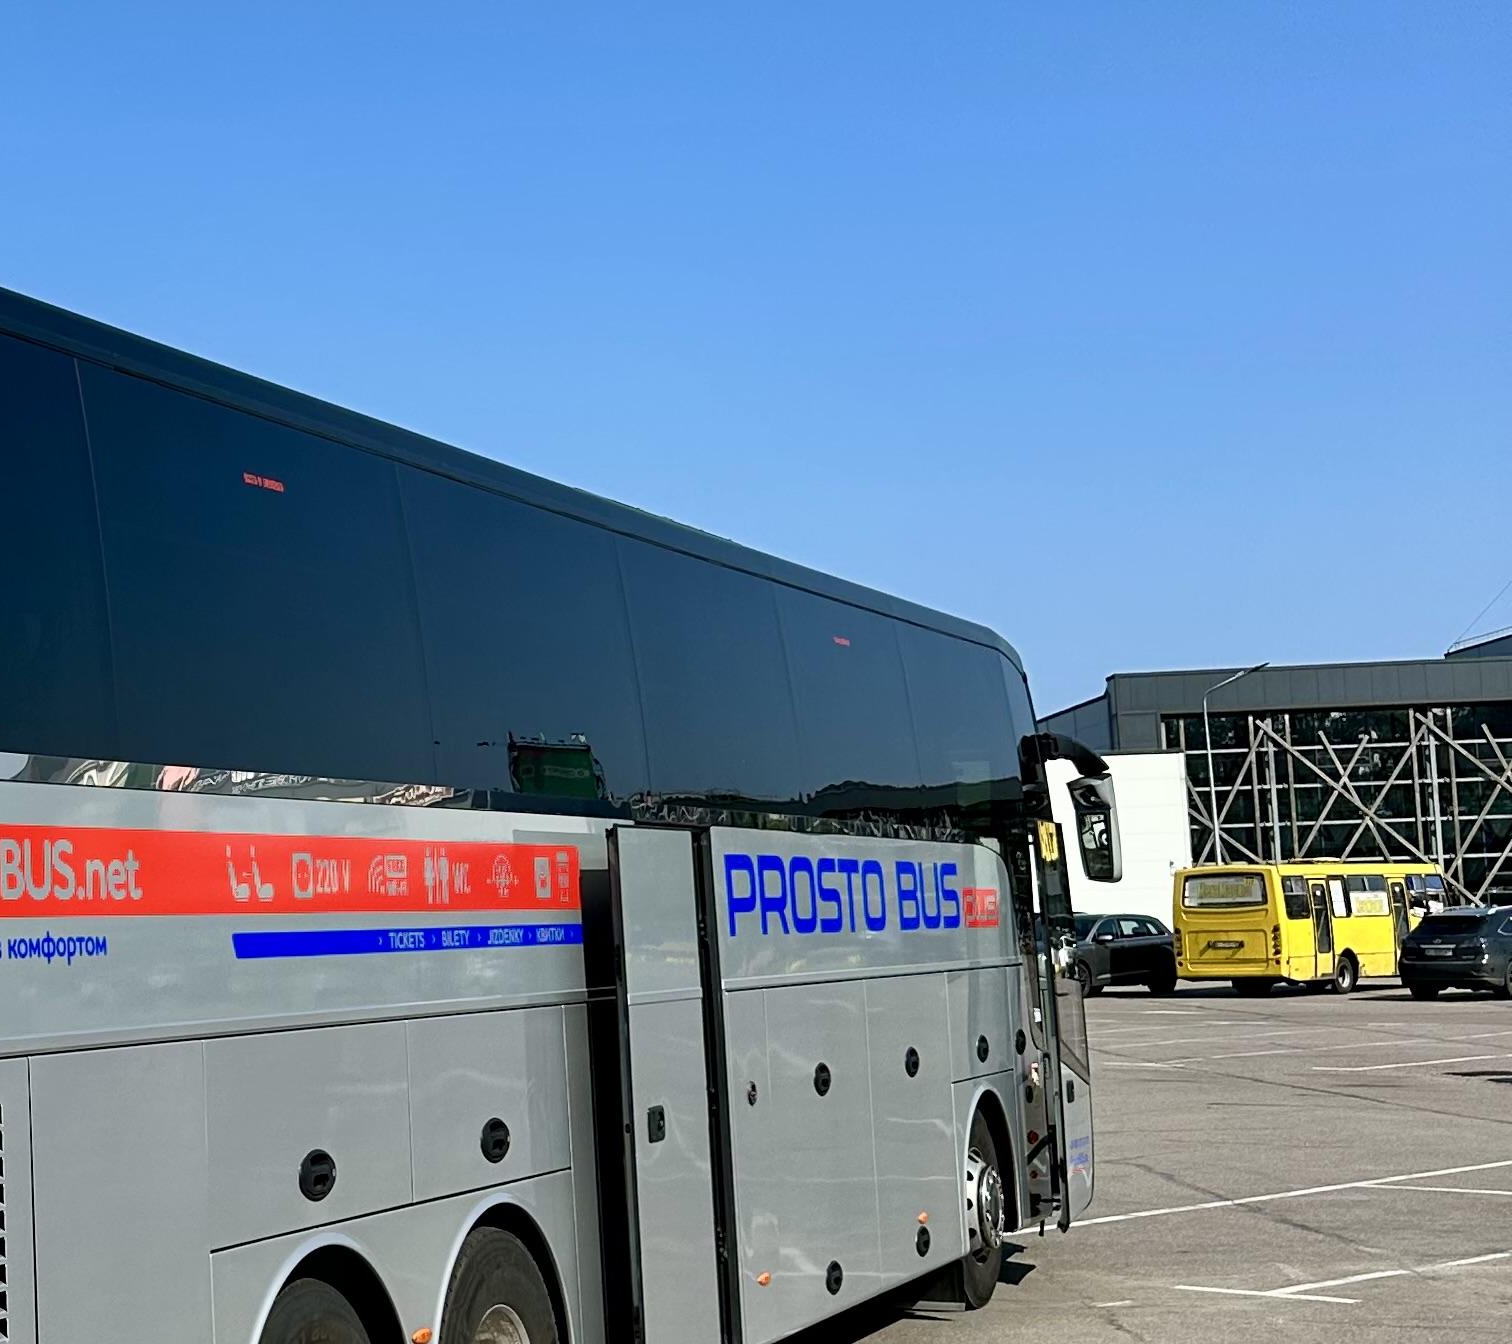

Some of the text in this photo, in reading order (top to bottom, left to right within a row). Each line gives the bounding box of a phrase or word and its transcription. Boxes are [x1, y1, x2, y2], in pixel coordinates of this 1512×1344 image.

[315, 859, 339, 895] 220
[723, 852, 888, 938] PROSTO
[894, 859, 963, 932] BUS
[7, 931, 109, 970] комфортом
[389, 931, 425, 950] TICKETS
